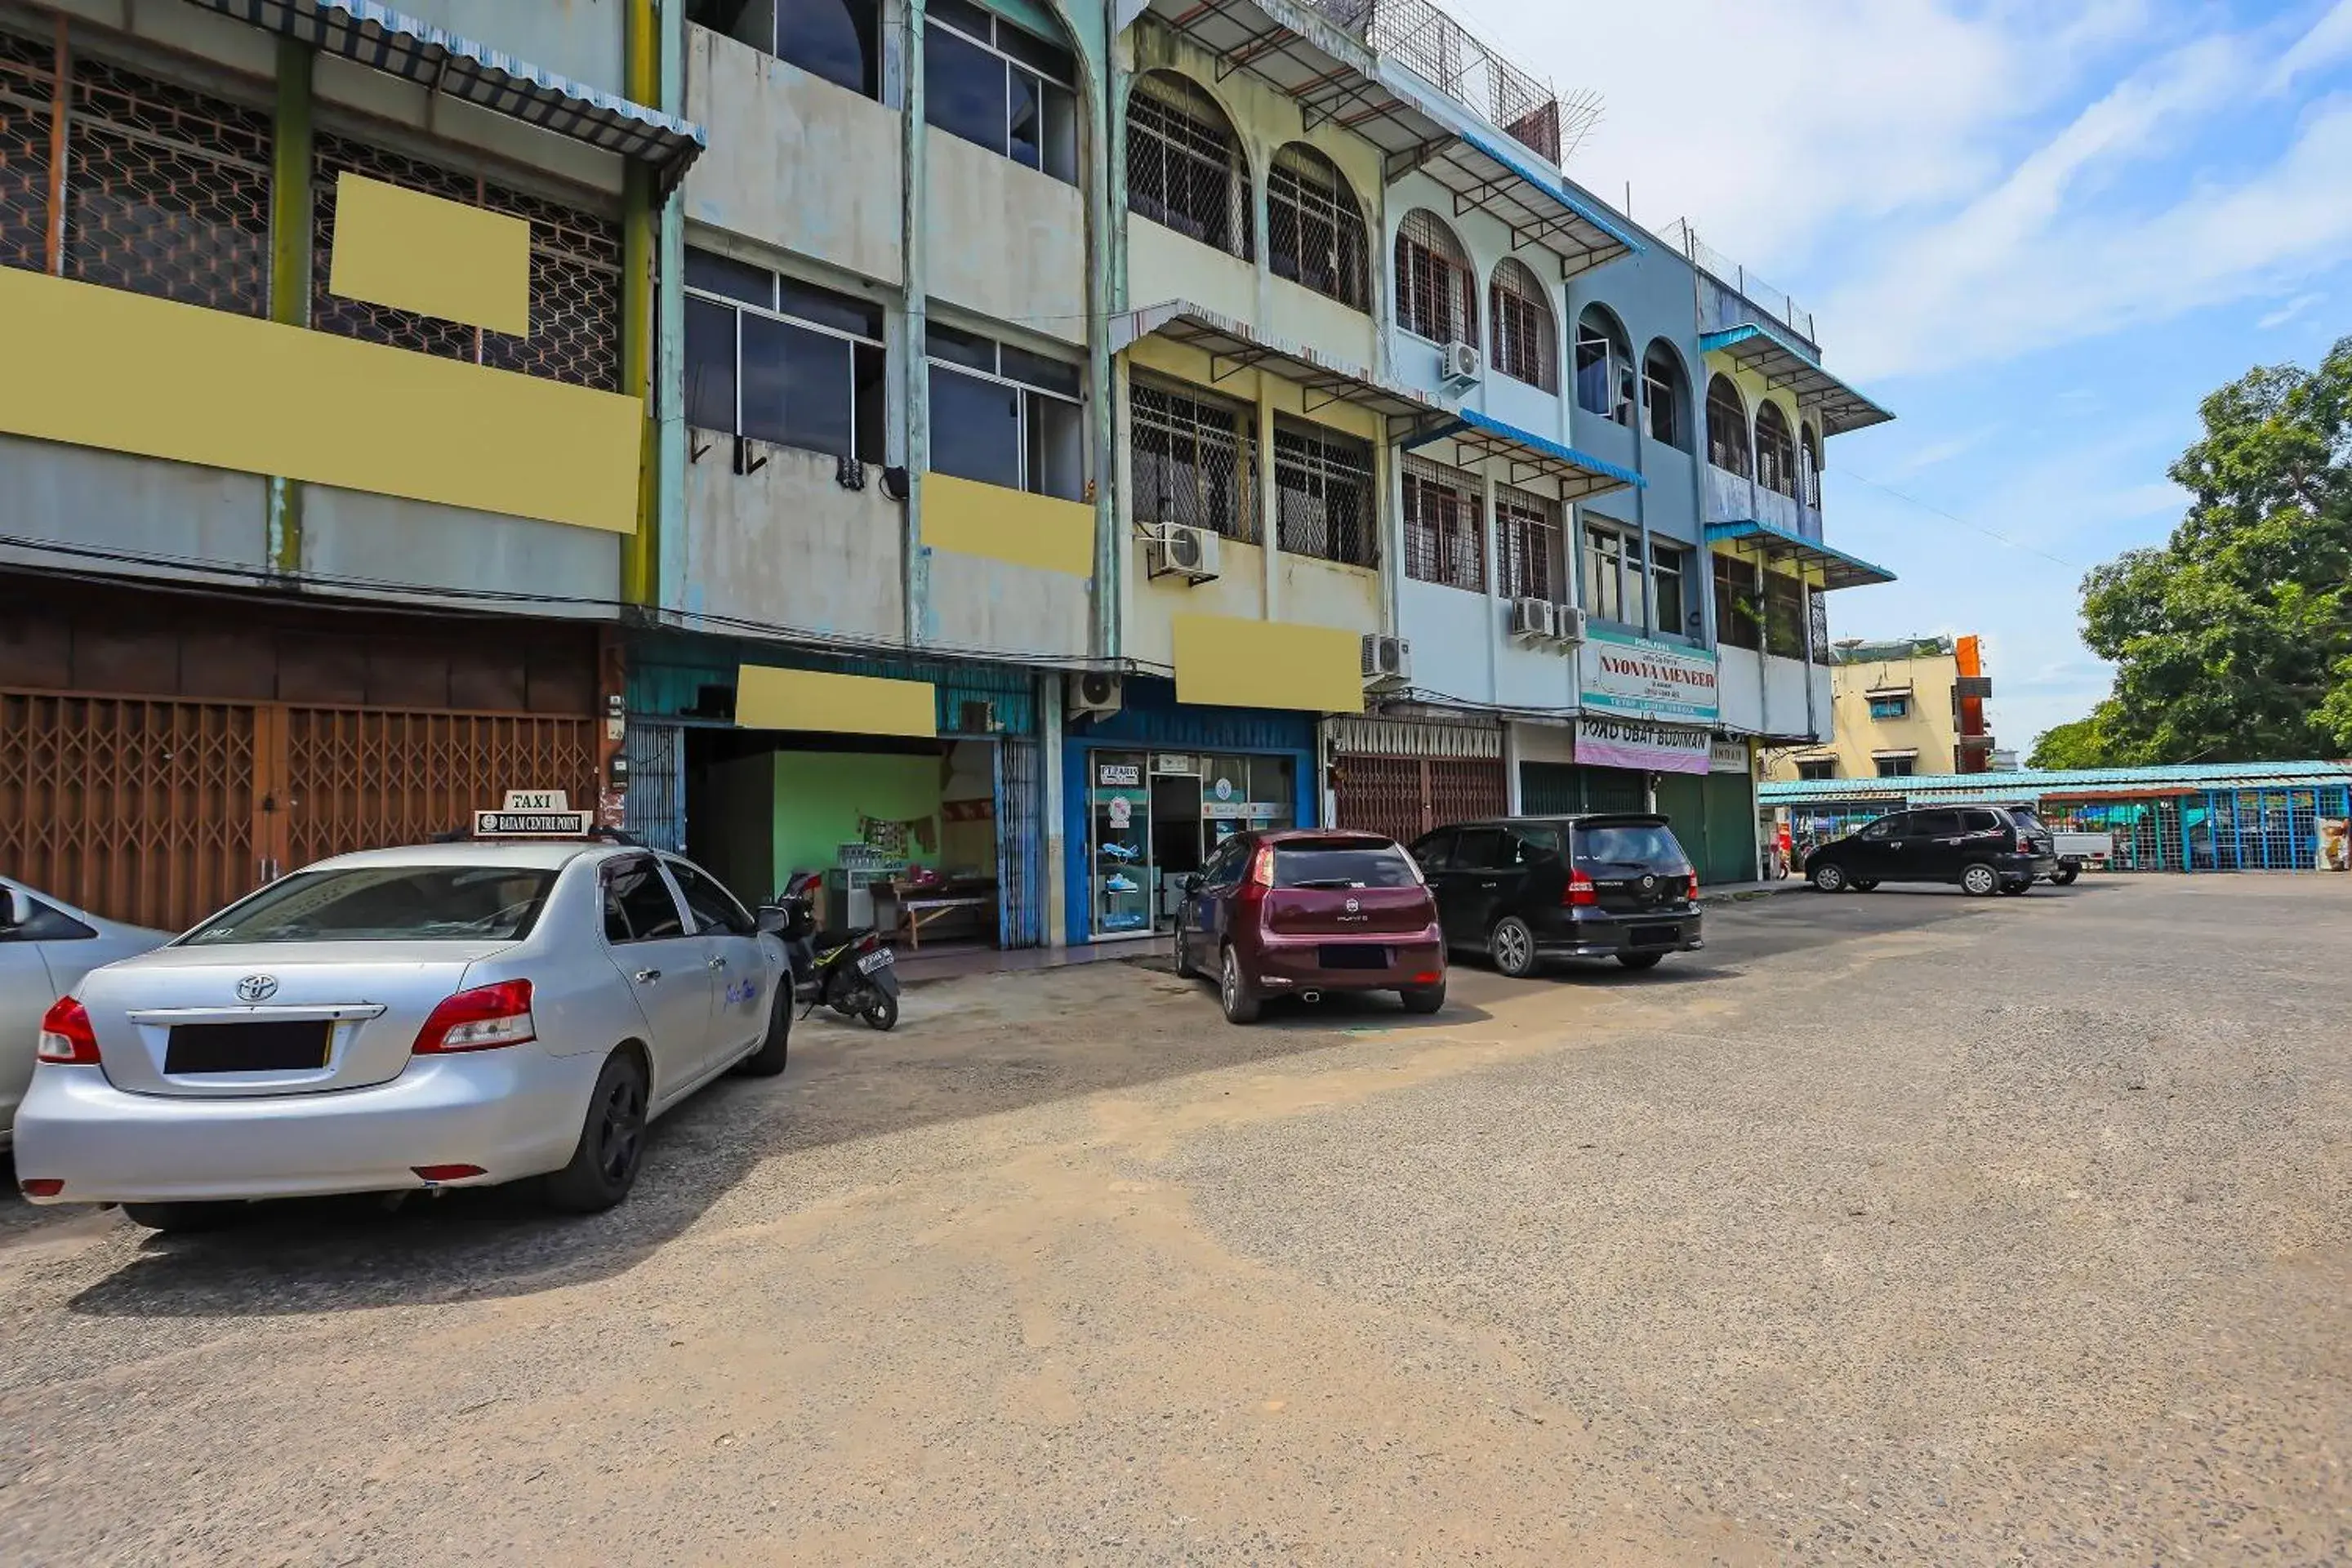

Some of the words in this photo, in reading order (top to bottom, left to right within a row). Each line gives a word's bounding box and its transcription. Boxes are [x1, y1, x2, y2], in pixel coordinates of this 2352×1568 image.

[1601, 656, 1658, 679] NYONYA
[1662, 666, 1714, 688] MENEER
[1582, 719, 1619, 740] TOKO
[1624, 724, 1655, 744] OBAT
[1657, 728, 1706, 750] BUDIMAN
[512, 795, 550, 808] TAXI
[500, 817, 524, 830] BATAM
[526, 817, 555, 830] CENTRE
[557, 817, 579, 830] POINT
